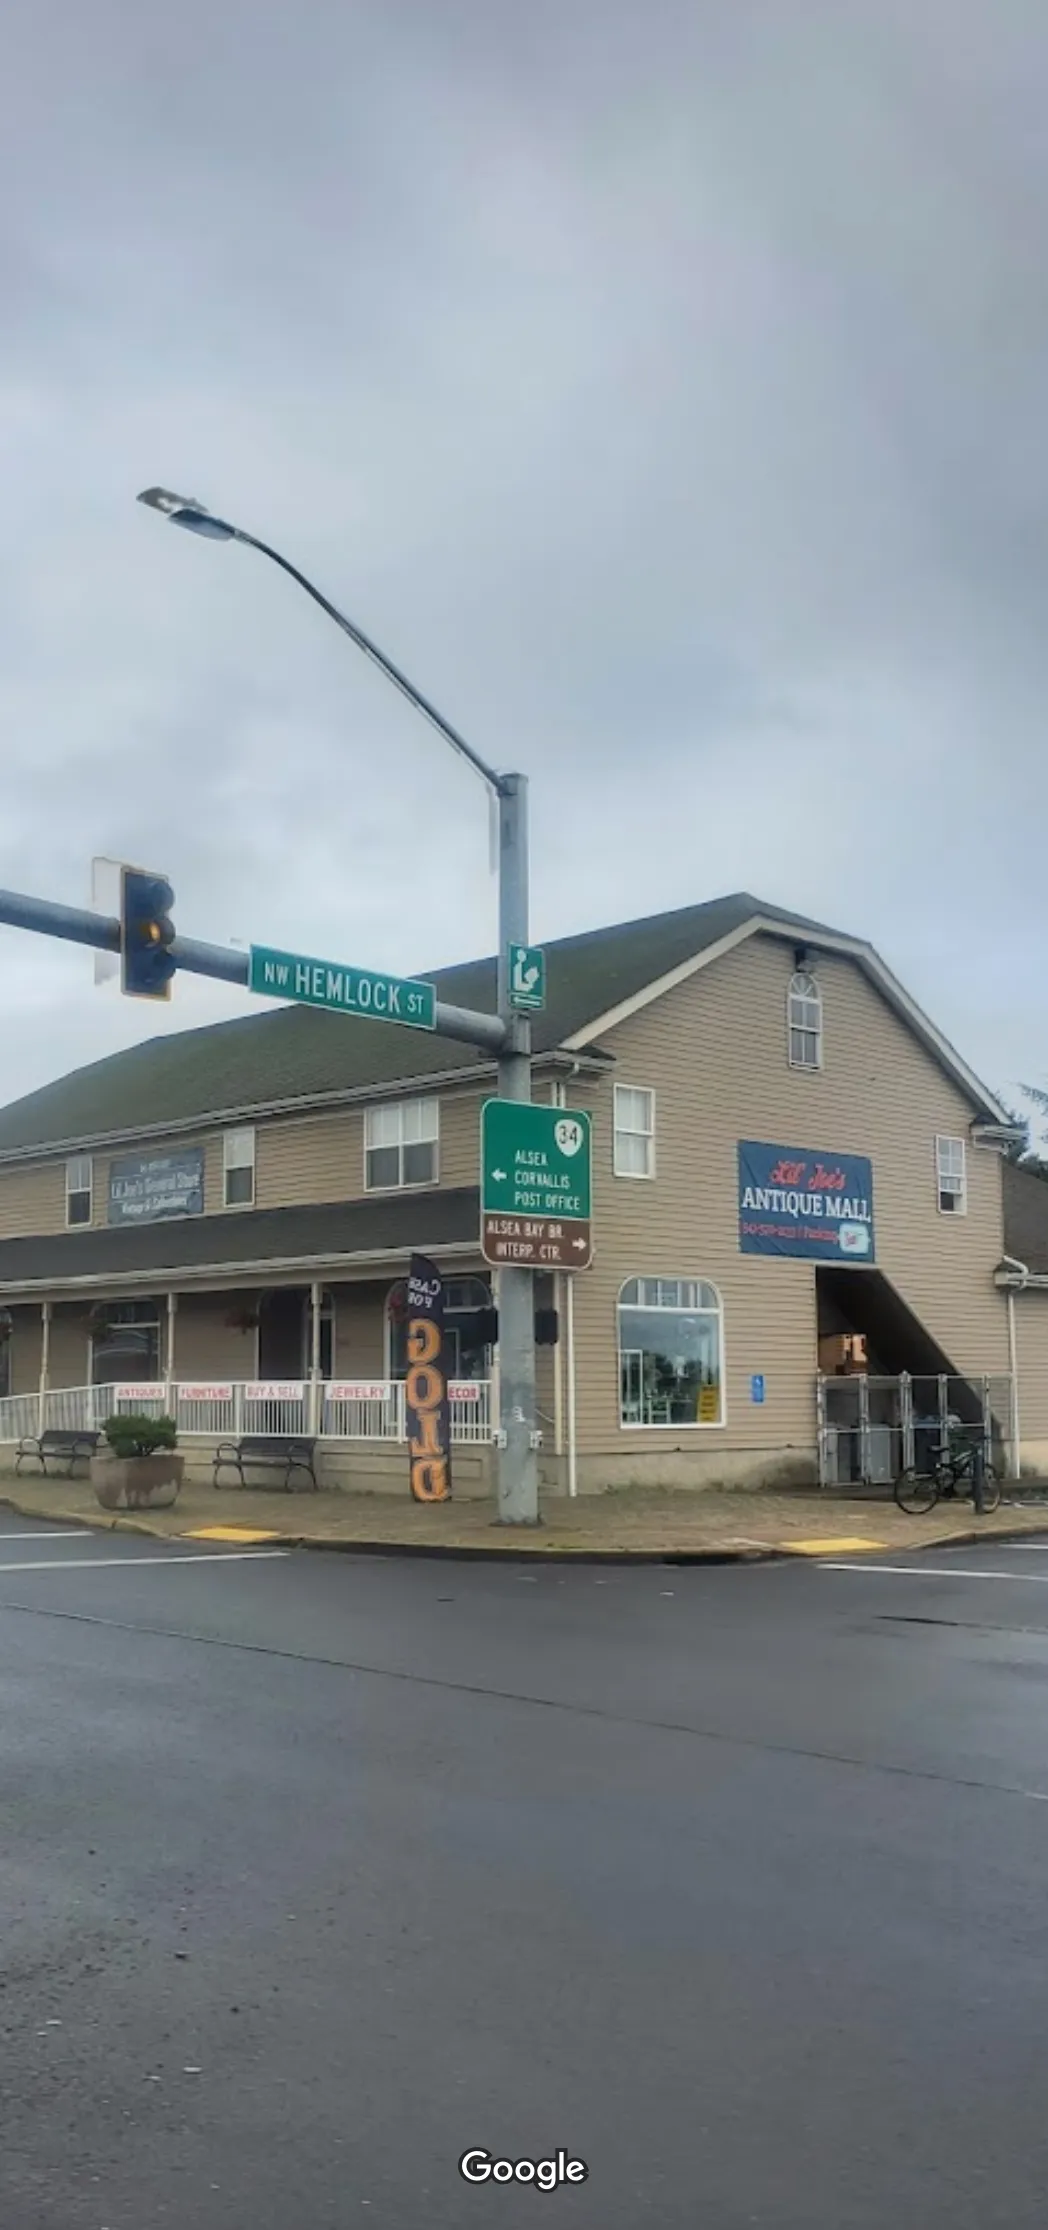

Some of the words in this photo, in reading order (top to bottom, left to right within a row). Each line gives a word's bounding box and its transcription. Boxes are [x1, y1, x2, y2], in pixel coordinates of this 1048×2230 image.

[264, 961, 289, 986] NW
[295, 963, 401, 1014] HEMLOCK
[407, 993, 424, 1015] ST
[558, 1125, 578, 1146] 34
[514, 1149, 548, 1167] ALSEA
[514, 1169, 571, 1190] CORVALLIS
[807, 1163, 847, 1190] Joe's
[514, 1191, 541, 1208] POST
[545, 1193, 580, 1211] OFFICE
[741, 1186, 823, 1218] ANTIQUE
[825, 1195, 872, 1223] MALL
[486, 1220, 521, 1237] ALSEA
[524, 1222, 545, 1238] BAY
[496, 1241, 536, 1258] INTERP.
[539, 1243, 562, 1261] CTR.
[117, 1386, 163, 1398] ANTIQUES
[181, 1385, 231, 1399] FURNITURE
[247, 1385, 265, 1398] BUY
[277, 1385, 298, 1399] SELL
[329, 1385, 386, 1399] JEWELRY
[448, 1386, 477, 1399] ECOR
